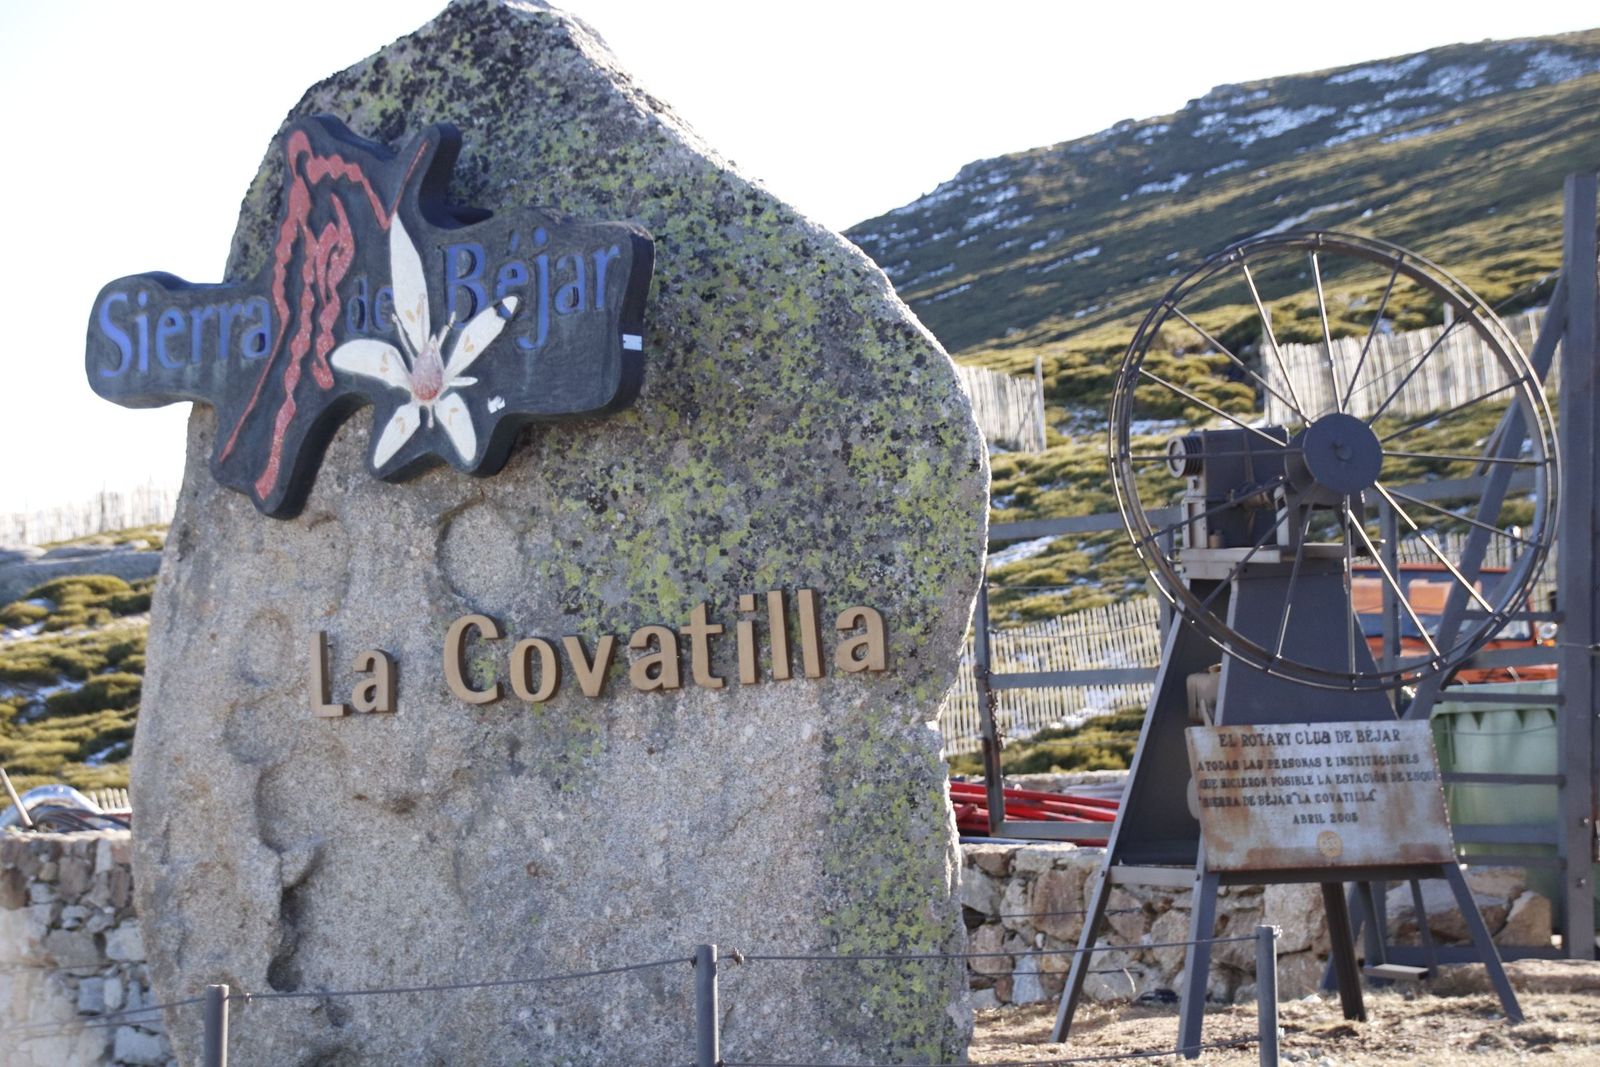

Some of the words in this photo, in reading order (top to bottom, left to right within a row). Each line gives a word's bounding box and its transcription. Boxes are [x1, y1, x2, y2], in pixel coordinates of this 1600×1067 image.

[100, 291, 273, 379] Sierra
[345, 275, 393, 334] de
[444, 225, 621, 350] Béjar
[309, 630, 396, 718] La
[443, 588, 888, 704] Covatilla
[1219, 733, 1239, 747] EL
[1241, 732, 1291, 747] ROTARY
[1295, 730, 1331, 745] CLUB
[1335, 729, 1353, 744] DE
[1204, 760, 1240, 772] TODAS
[1243, 758, 1264, 771] LAS
[1266, 756, 1322, 770] PERSONAS
[1325, 756, 1333, 768] E
[1335, 753, 1420, 768] INSTITUCIONES
[1220, 776, 1268, 789] HICIERON
[1270, 775, 1314, 788] POSIBLE
[1318, 774, 1332, 786] LA
[1391, 771, 1405, 784] DE
[1243, 795, 1257, 807] DE
[1292, 813, 1326, 825] ABRIL
